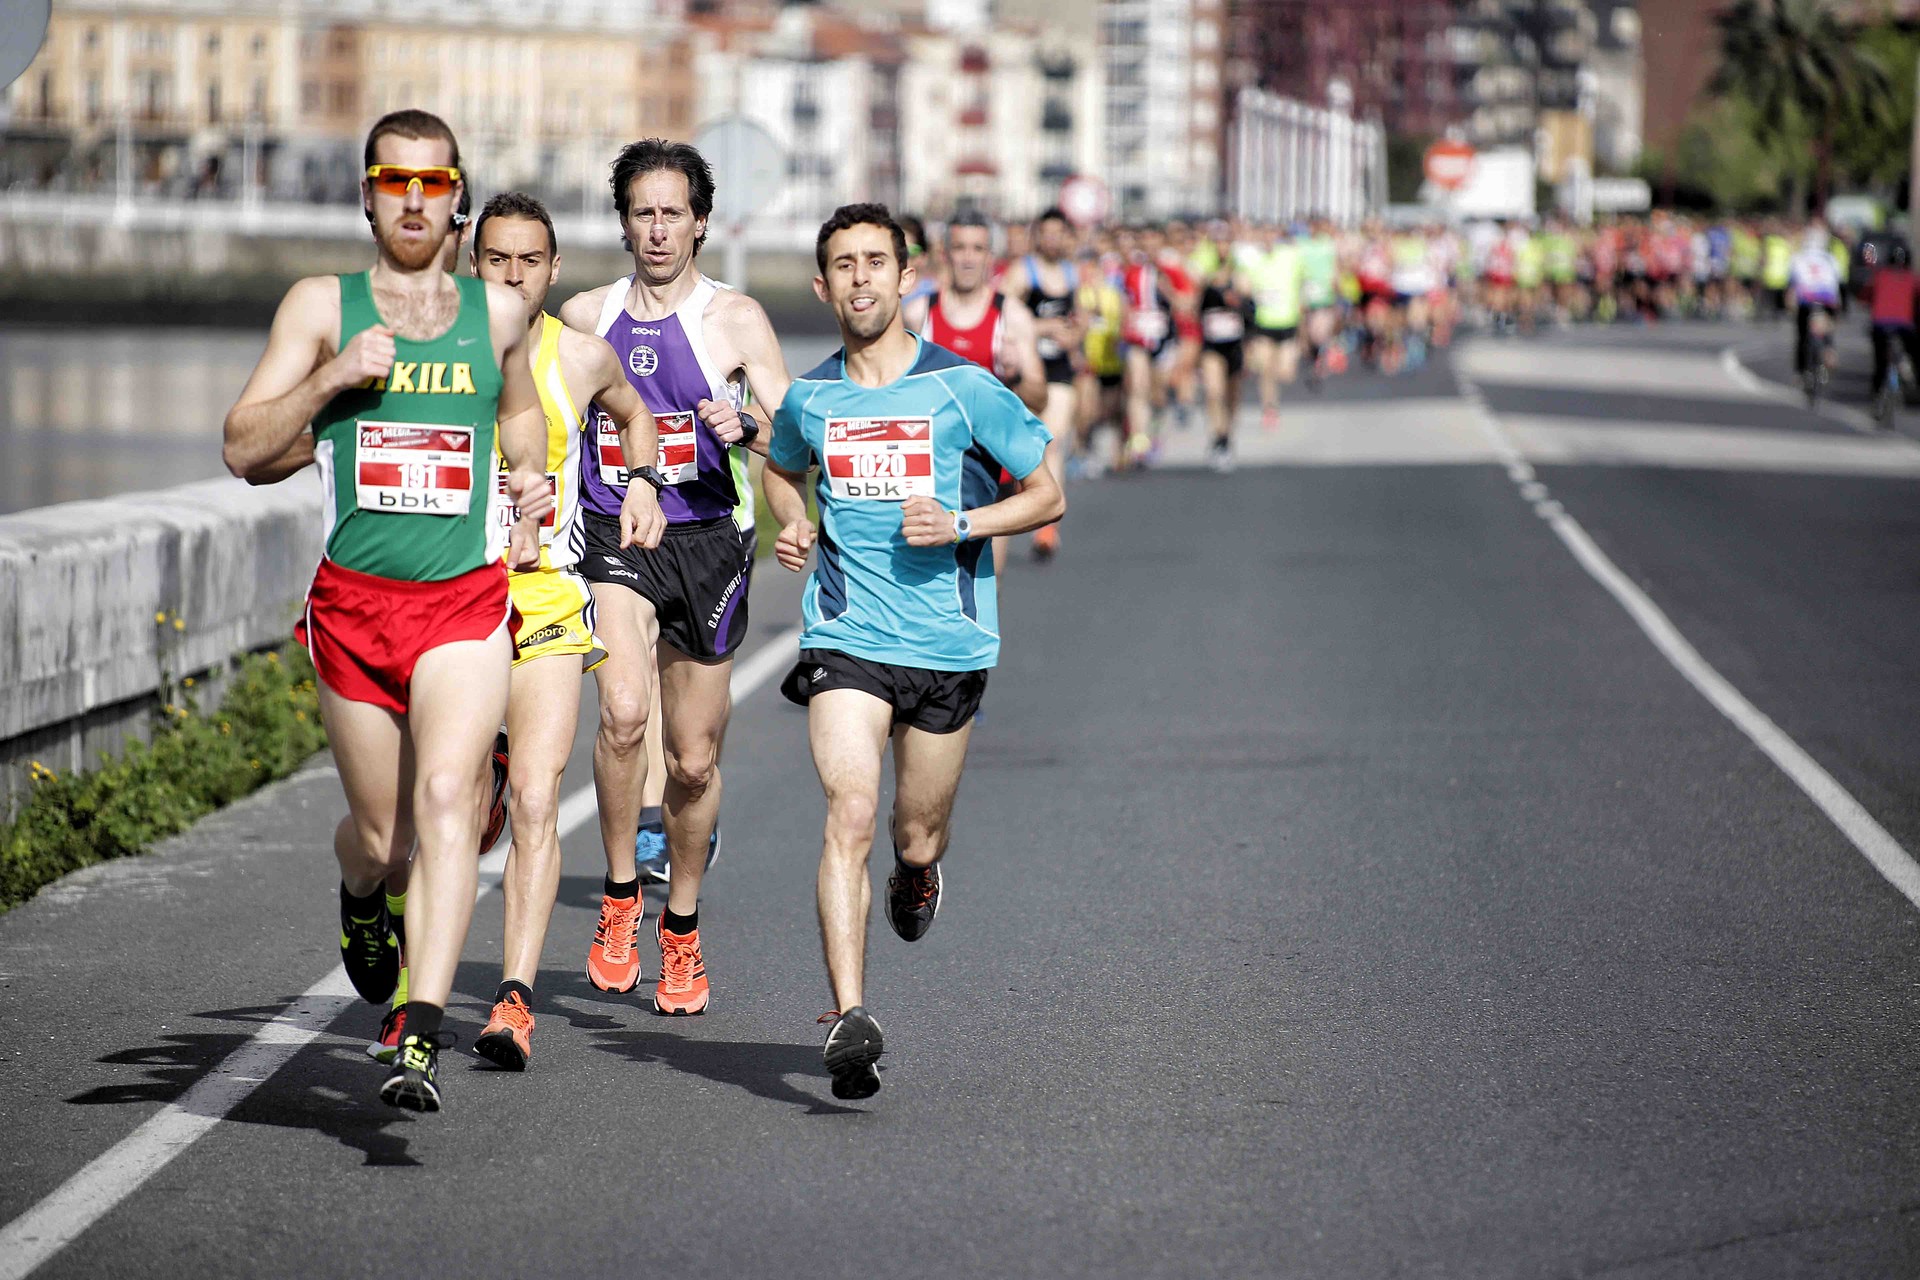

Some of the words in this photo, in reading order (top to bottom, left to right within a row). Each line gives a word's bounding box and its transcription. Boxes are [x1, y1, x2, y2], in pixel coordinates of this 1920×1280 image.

[356, 362, 477, 394] KILA
[397, 463, 436, 489] 191
[849, 453, 907, 477] 1020
[379, 491, 440, 508] bbk
[846, 482, 900, 497] bbk
